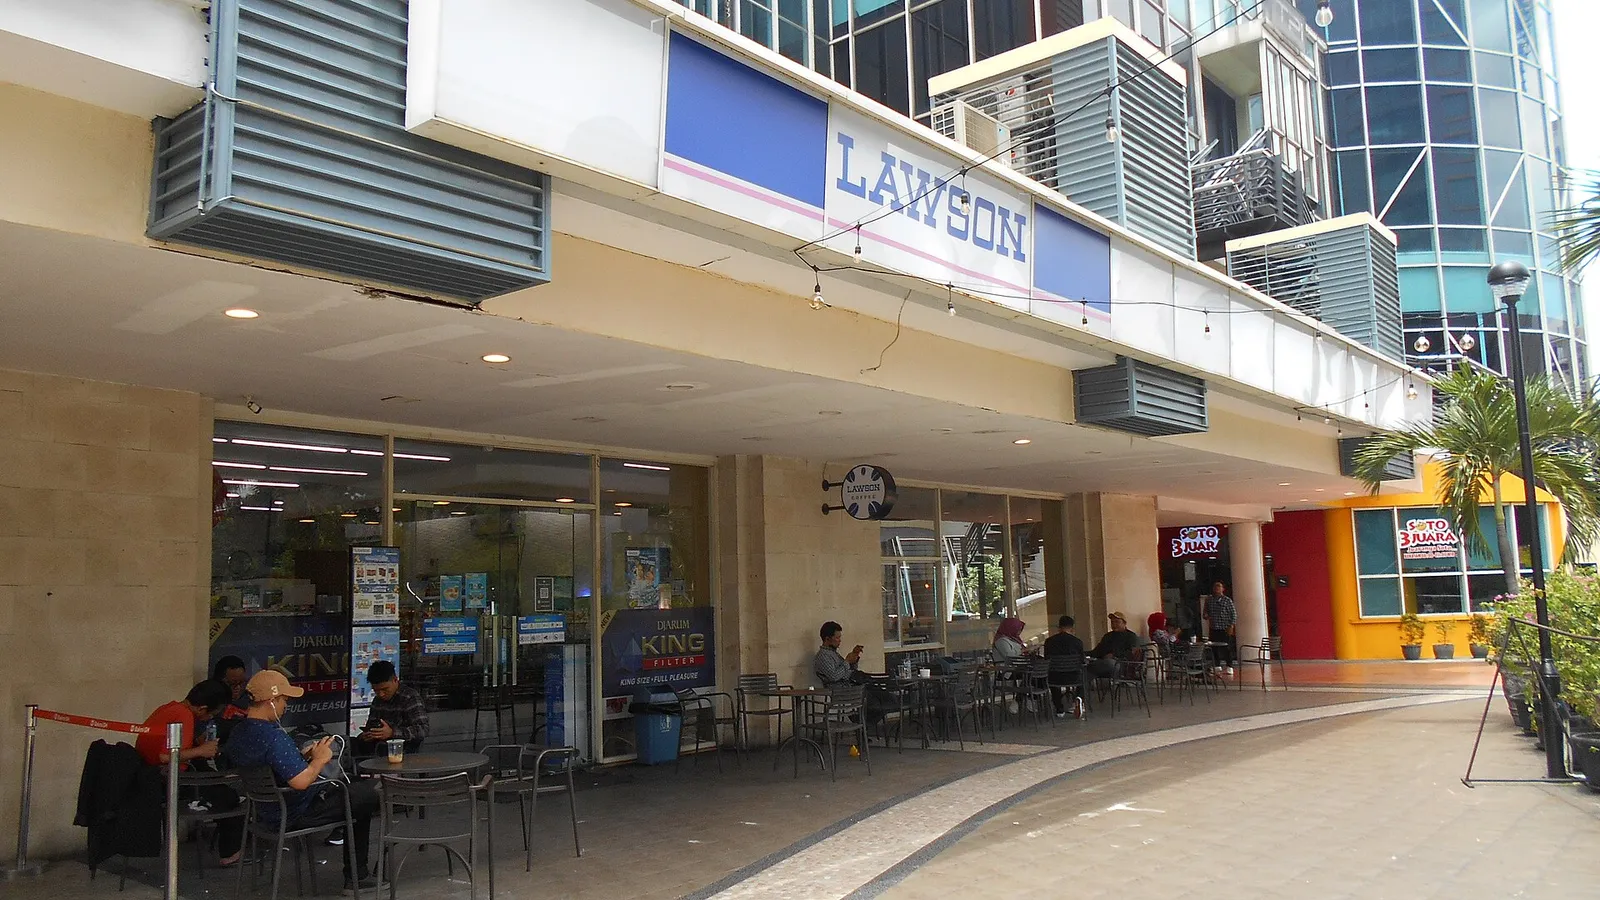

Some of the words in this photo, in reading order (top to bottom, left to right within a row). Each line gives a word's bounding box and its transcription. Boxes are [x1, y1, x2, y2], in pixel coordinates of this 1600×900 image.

[836, 132, 1027, 263] LAWSON
[847, 484, 880, 493] LAWSON
[1400, 532, 1411, 547] 3
[1412, 532, 1456, 544] JUARA
[1172, 540, 1183, 556] 3
[601, 612, 611, 629] NEW
[657, 620, 690, 631] DJARUM
[293, 635, 344, 648] DJARUM
[642, 633, 705, 655] KING
[654, 658, 695, 667] FILTER
[620, 678, 636, 686] KING
[653, 675, 668, 683] FULL
[669, 672, 699, 681] PLEASURE
